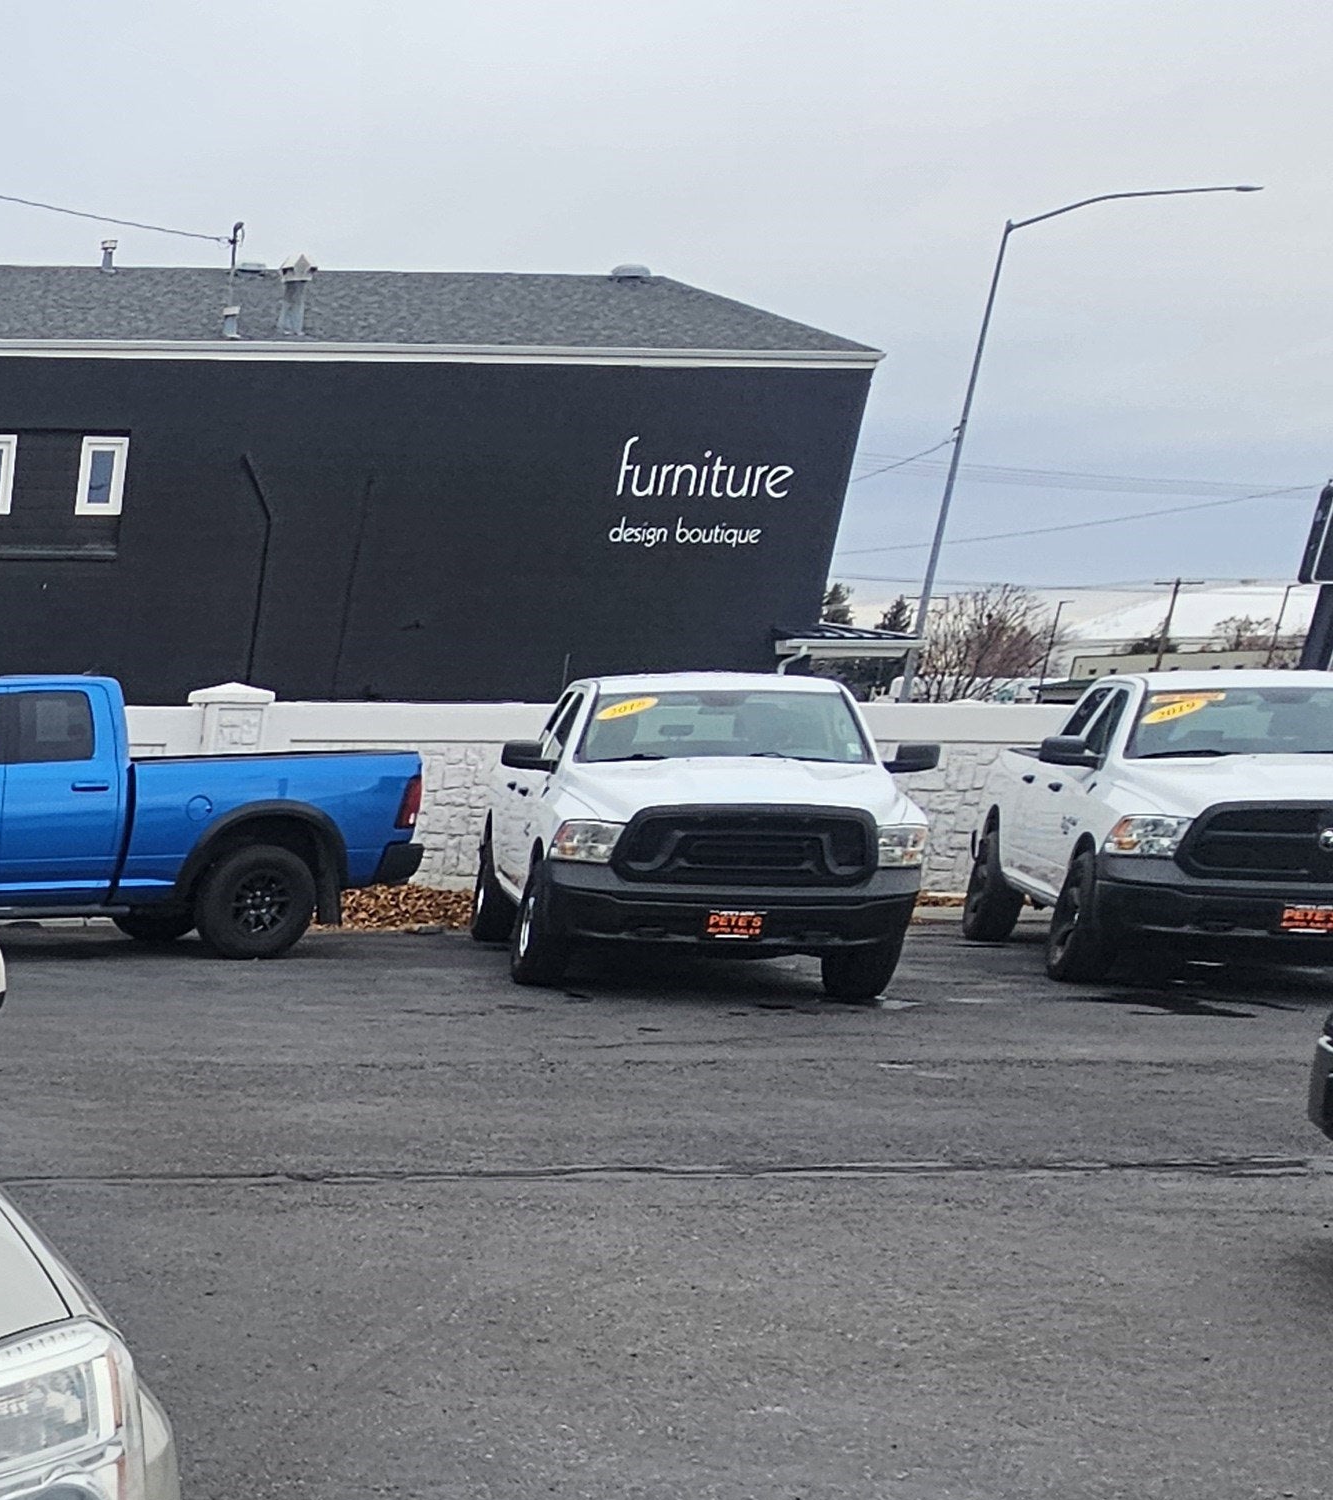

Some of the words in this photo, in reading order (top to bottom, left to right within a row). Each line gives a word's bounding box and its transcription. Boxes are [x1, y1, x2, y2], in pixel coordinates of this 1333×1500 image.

[616, 436, 795, 499] furniture
[608, 516, 669, 548] design
[675, 516, 762, 548] boutique
